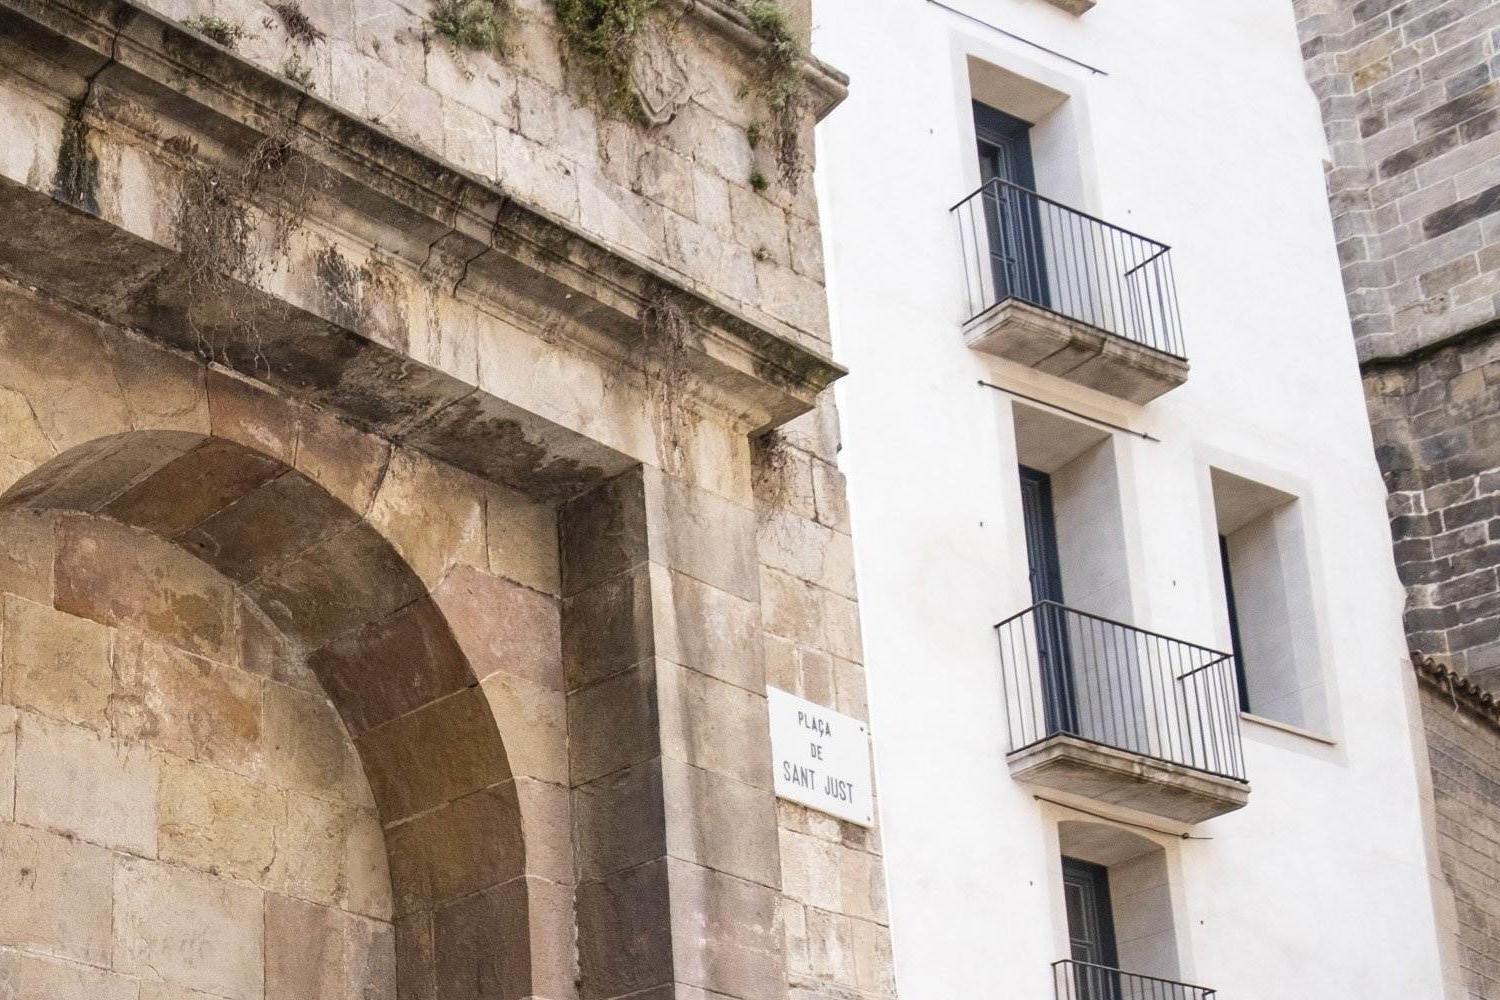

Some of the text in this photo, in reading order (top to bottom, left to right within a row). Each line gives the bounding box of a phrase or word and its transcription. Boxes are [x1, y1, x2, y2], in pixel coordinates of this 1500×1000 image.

[798, 711, 831, 737] PLAÇA
[810, 743, 823, 760] DE
[783, 761, 853, 804] SANT JUST
